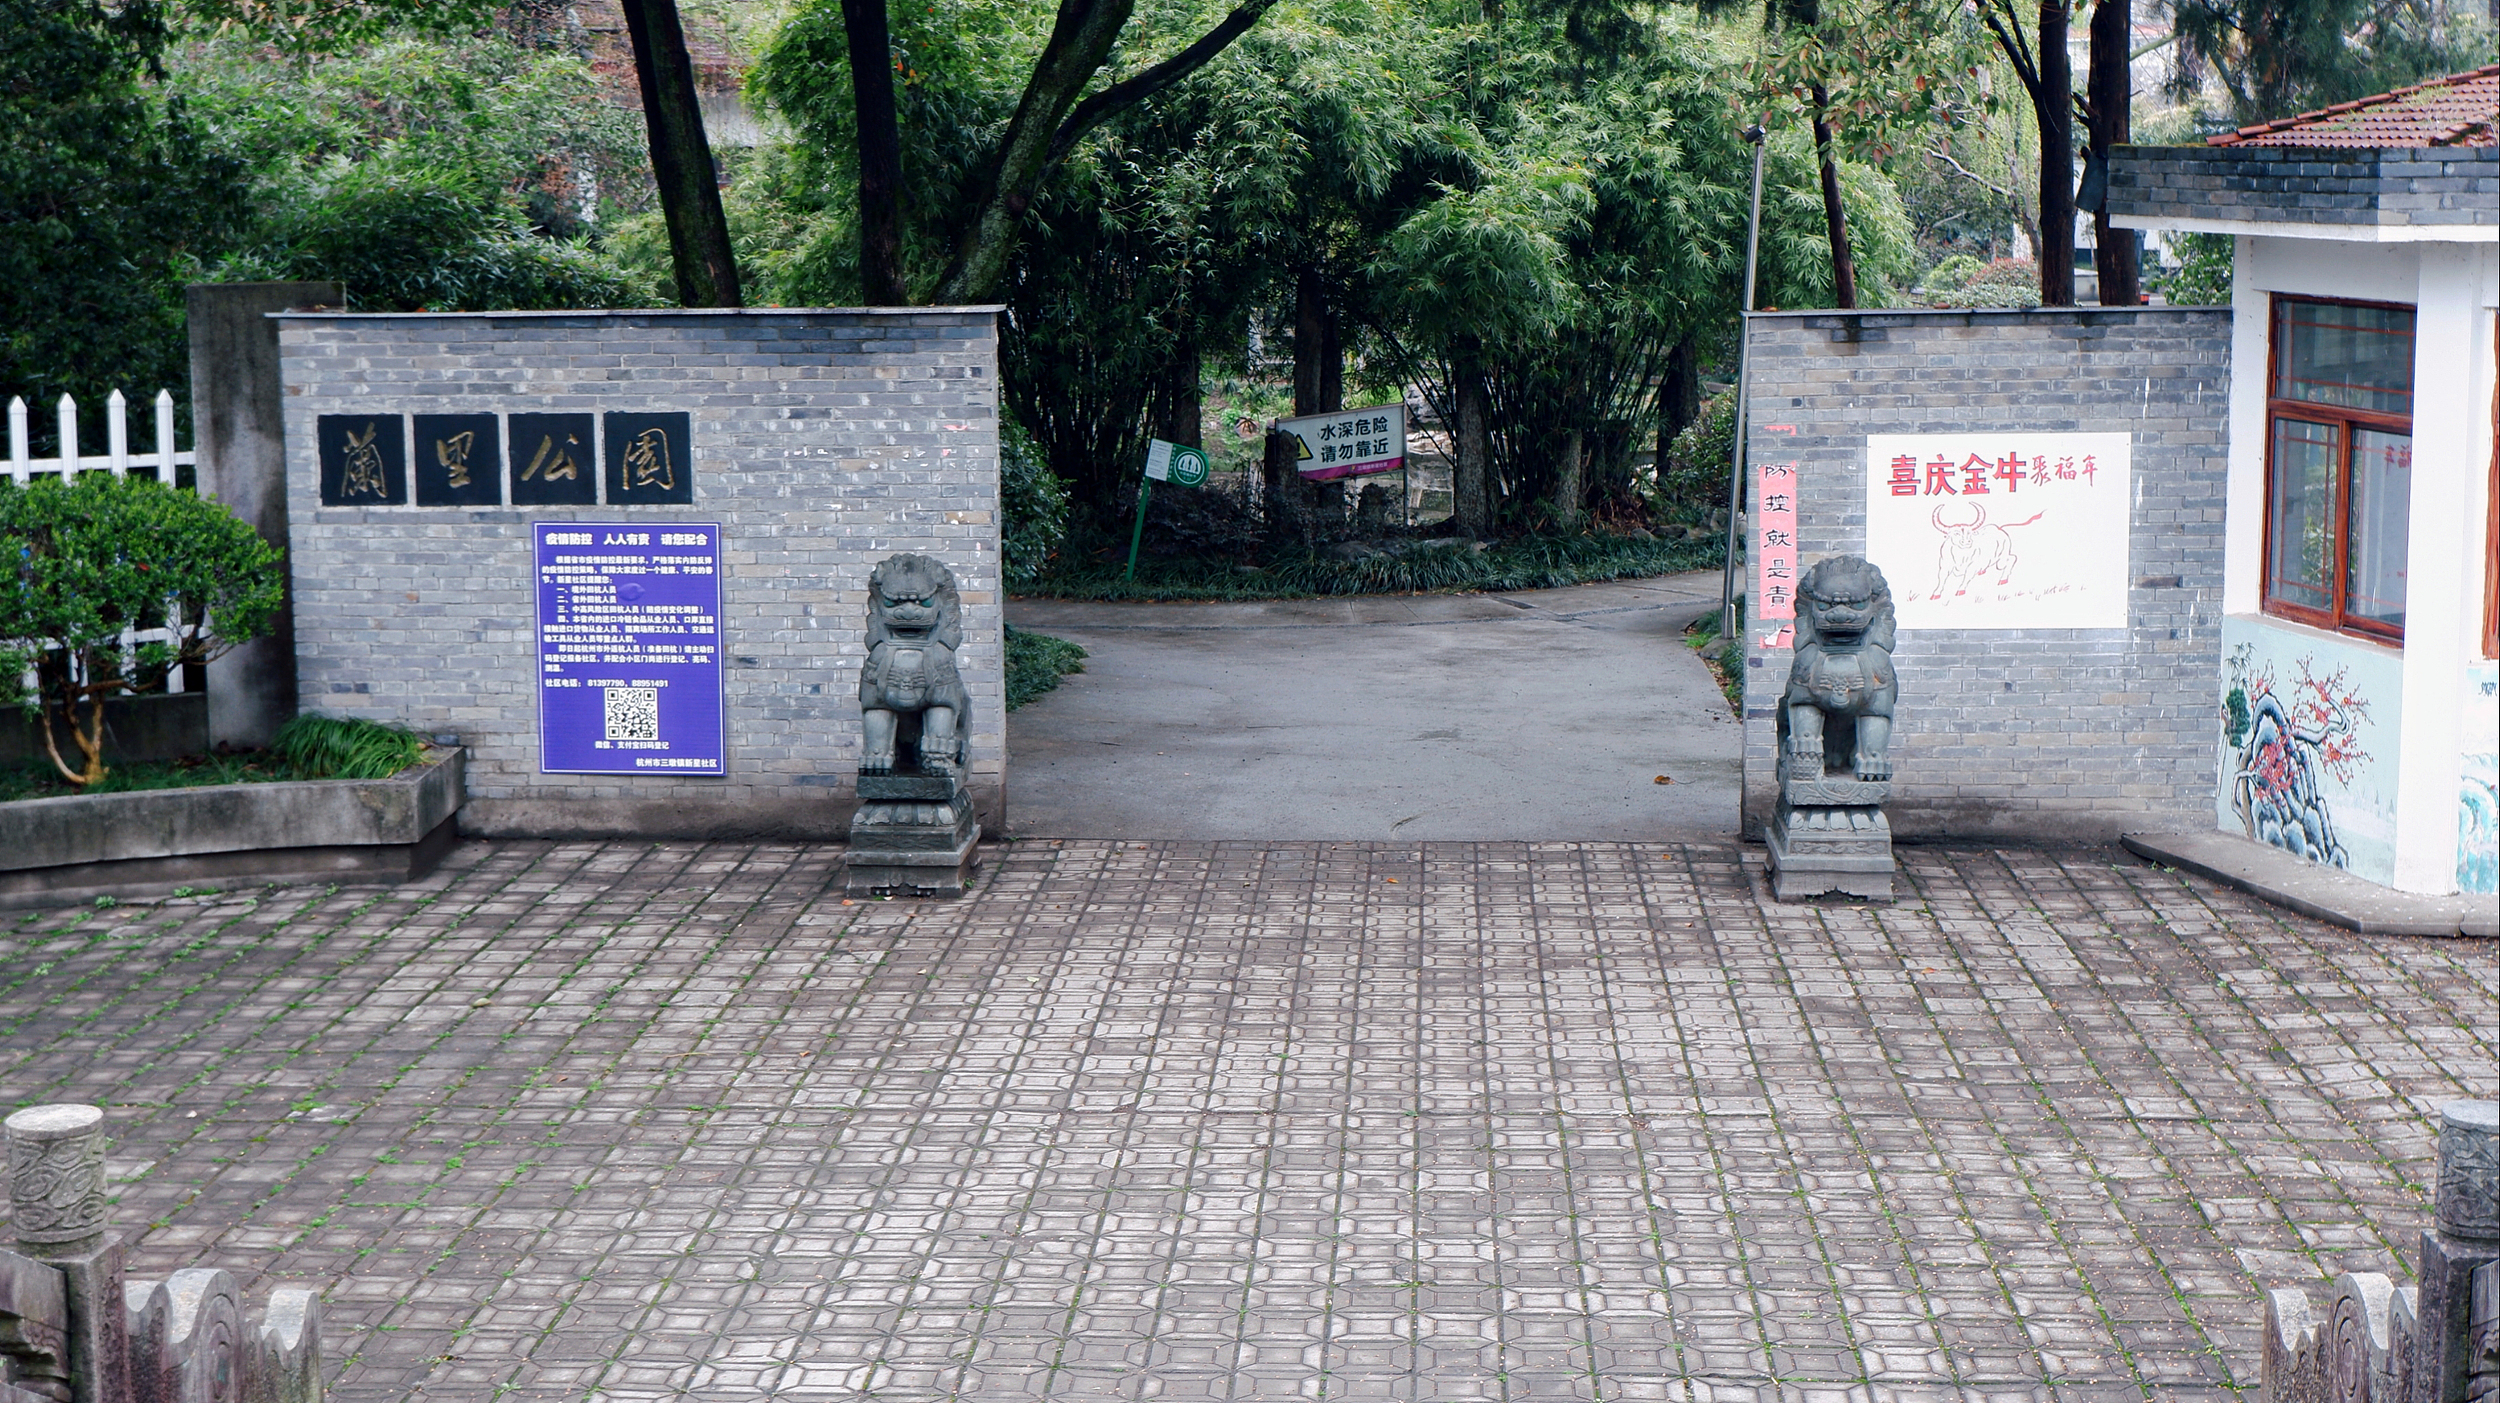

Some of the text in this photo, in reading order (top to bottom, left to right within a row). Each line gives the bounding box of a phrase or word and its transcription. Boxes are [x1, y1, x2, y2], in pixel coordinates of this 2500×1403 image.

[1320, 416, 1388, 441] 水深危险
[1321, 438, 1388, 463] 请勿靠近
[1887, 452, 2027, 496] 喜庆金牛
[545, 533, 708, 546] 疫情防控 人人有责 请您配合
[1763, 464, 1792, 634] 防控就是责
